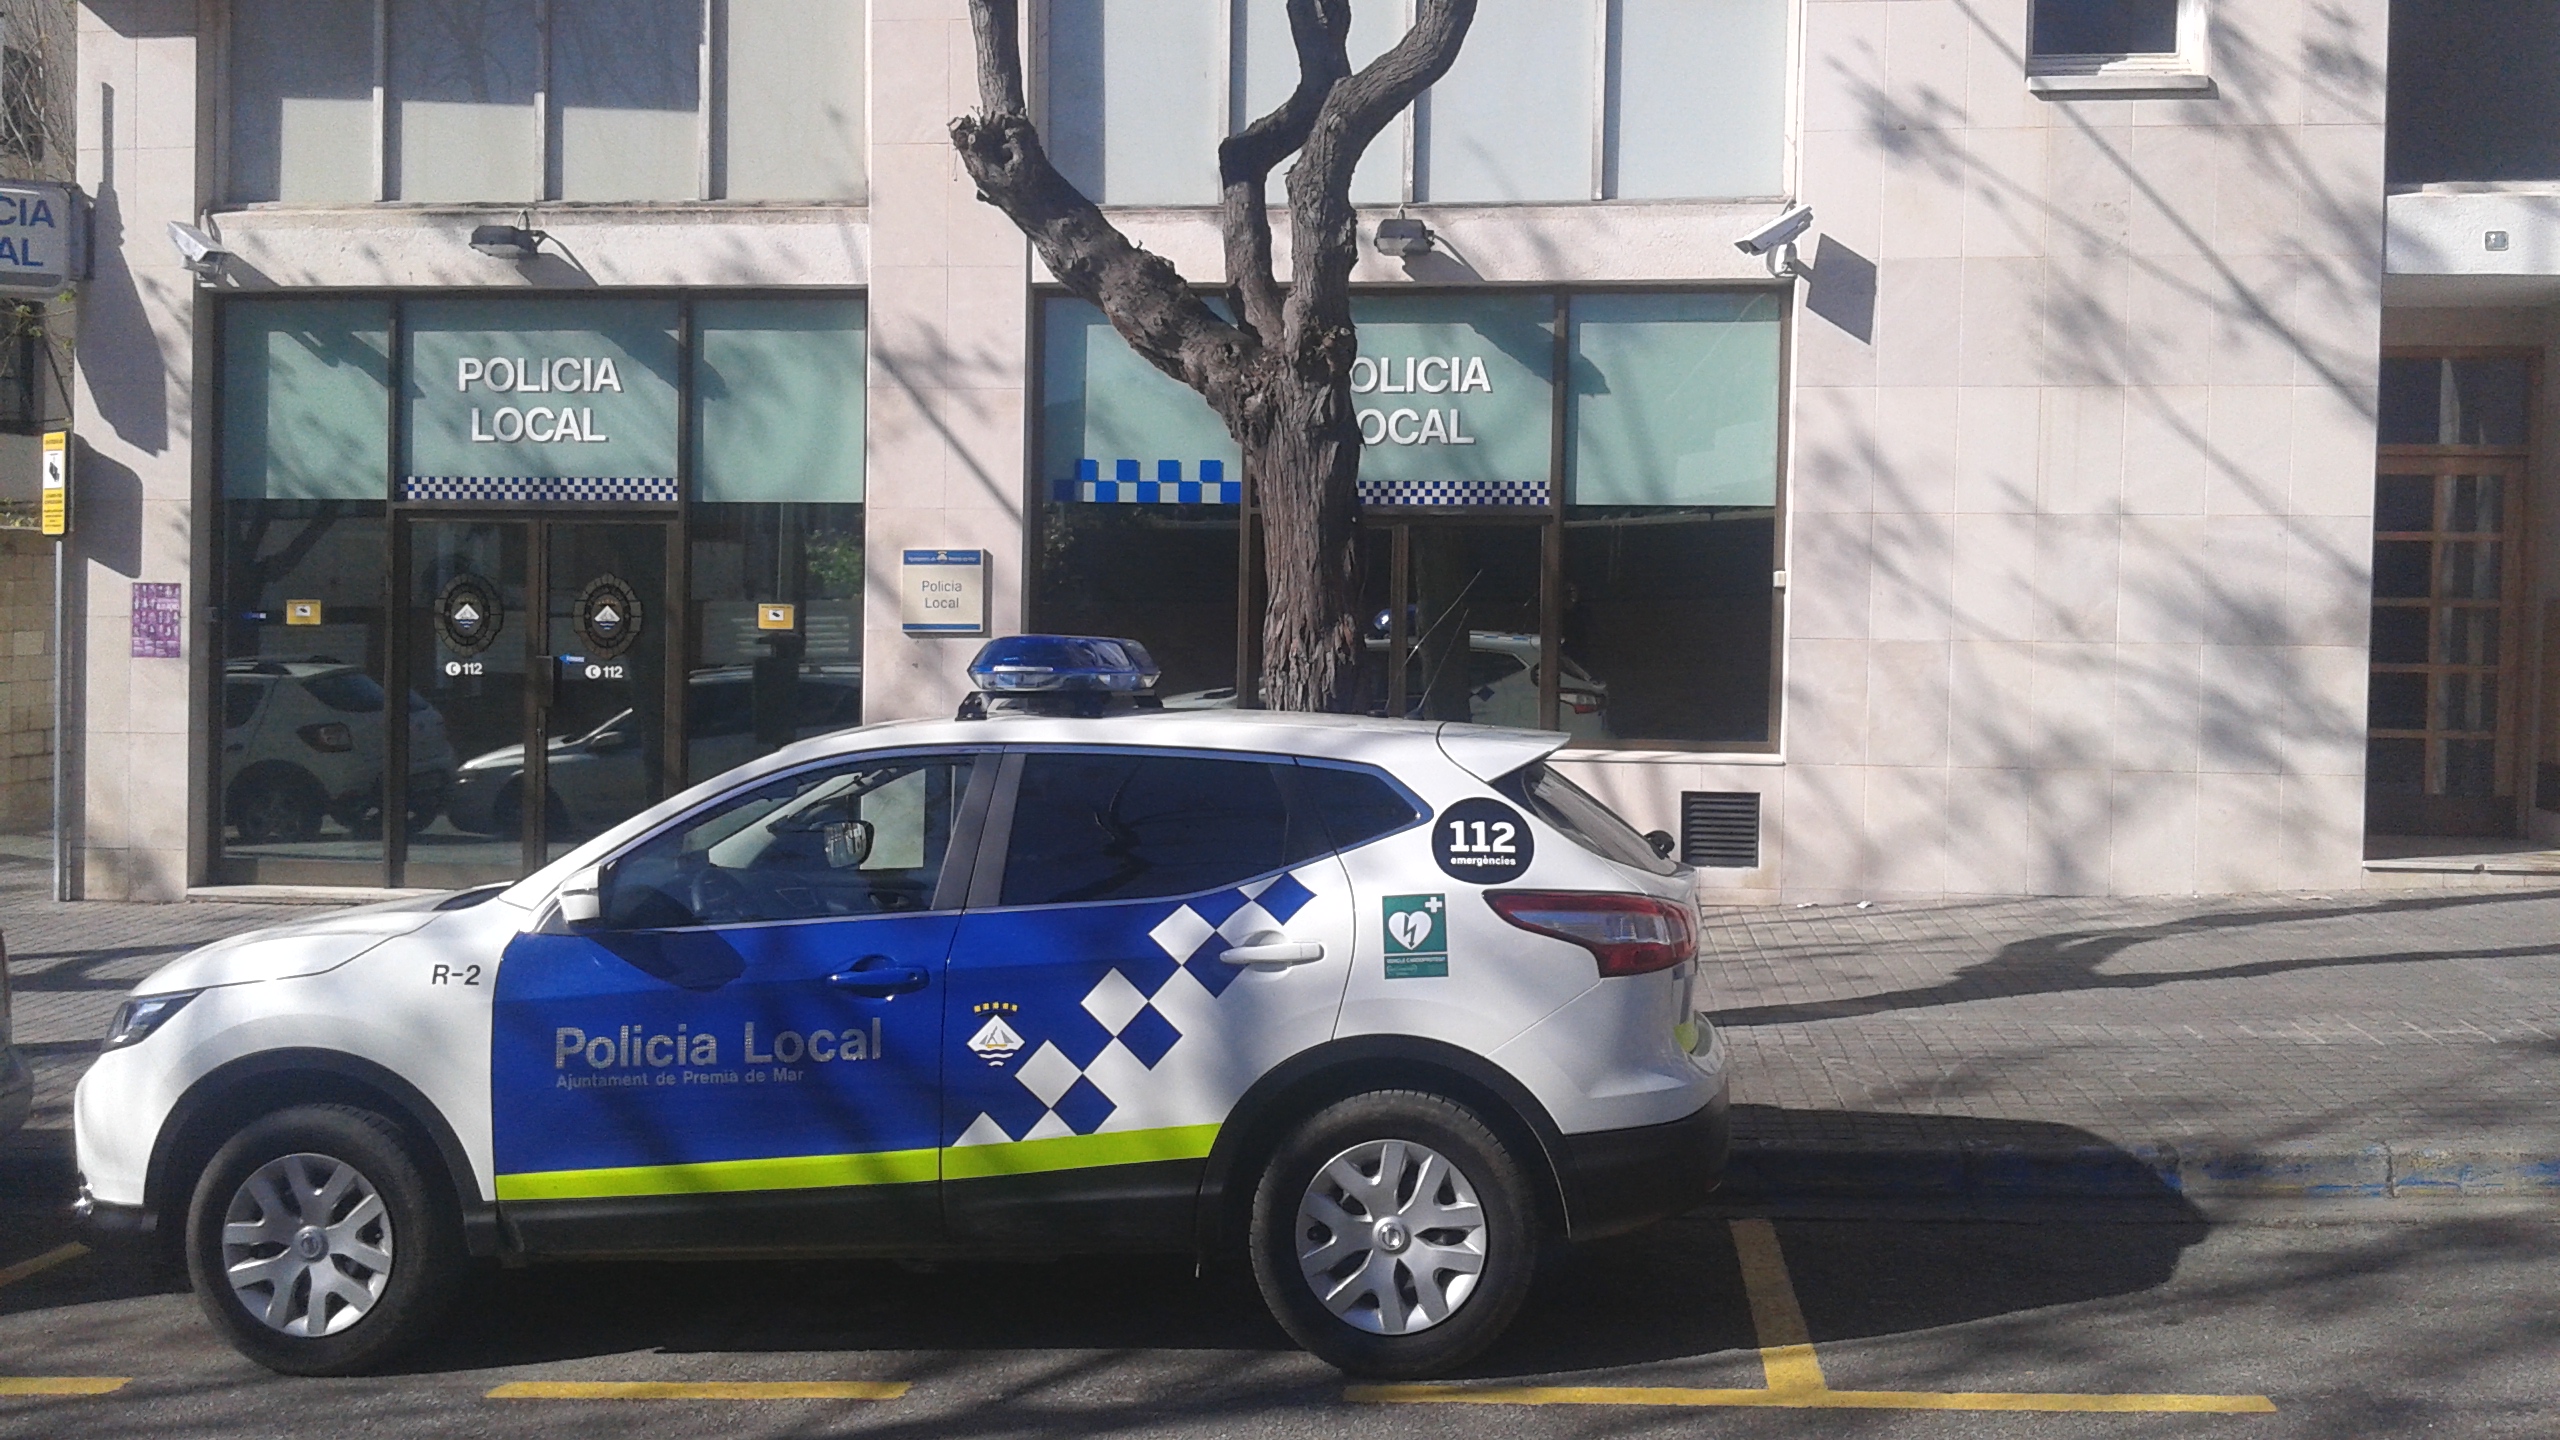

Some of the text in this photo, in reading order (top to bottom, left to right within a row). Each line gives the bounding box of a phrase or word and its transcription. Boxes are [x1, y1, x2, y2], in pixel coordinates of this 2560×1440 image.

[458, 357, 622, 392] POLICIA
[1350, 356, 1492, 393] OLICIA
[471, 407, 607, 442] LOCAL
[1357, 408, 1475, 445] OCAL
[921, 580, 963, 593] Policia
[925, 597, 960, 609] Local
[463, 662, 483, 675] 112
[603, 665, 623, 679] 112
[1450, 820, 1516, 853] 112
[1450, 854, 1517, 867] emergències
[431, 964, 481, 986] R-2
[555, 1017, 881, 1069] Policia Local
[556, 1073, 648, 1091] Ajuntament
[656, 1071, 676, 1086] de
[745, 1069, 766, 1083] de
[773, 1066, 804, 1082] Mar
